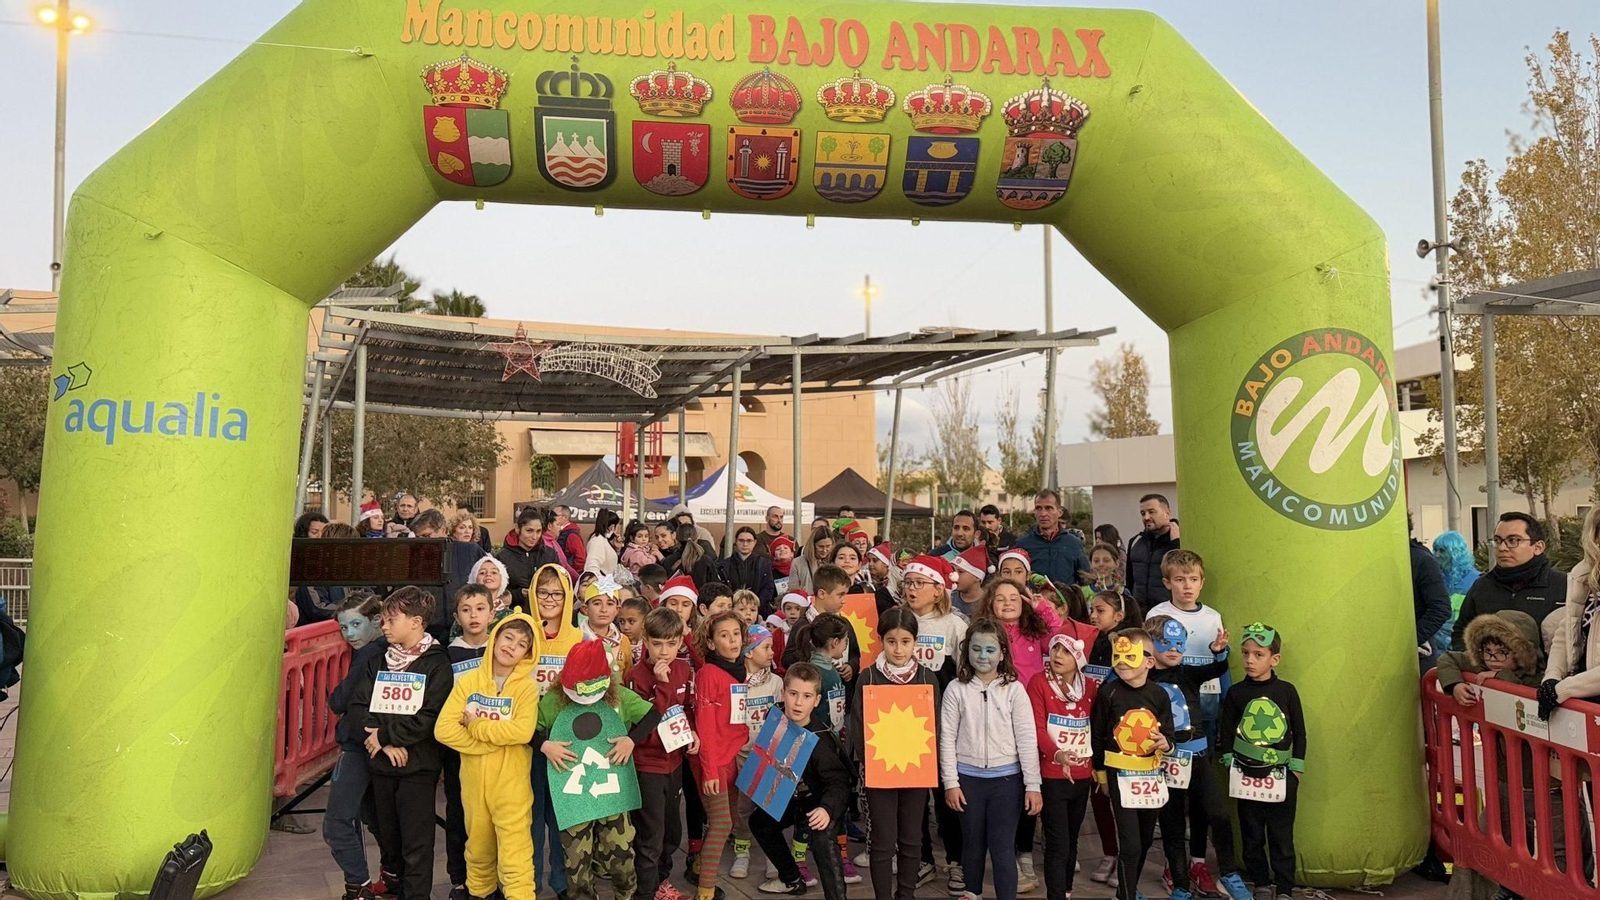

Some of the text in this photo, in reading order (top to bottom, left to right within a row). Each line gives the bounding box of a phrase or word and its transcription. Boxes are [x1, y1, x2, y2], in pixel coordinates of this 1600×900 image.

[400, 0, 1111, 77] Mancomunidad BAJO ANDARAX
[1235, 349, 1292, 417] BAJO
[64, 391, 248, 445] aqualia
[1238, 436, 1400, 525] MANCOMUNIDAD
[916, 647, 934, 660] 10
[536, 670, 558, 683] 50
[382, 686, 412, 701] 580
[750, 709, 768, 721] 47
[669, 718, 690, 736] 52
[1058, 731, 1086, 745] 572
[1160, 760, 1180, 776] 26
[1131, 781, 1160, 796] 524
[1241, 775, 1275, 790] 589
